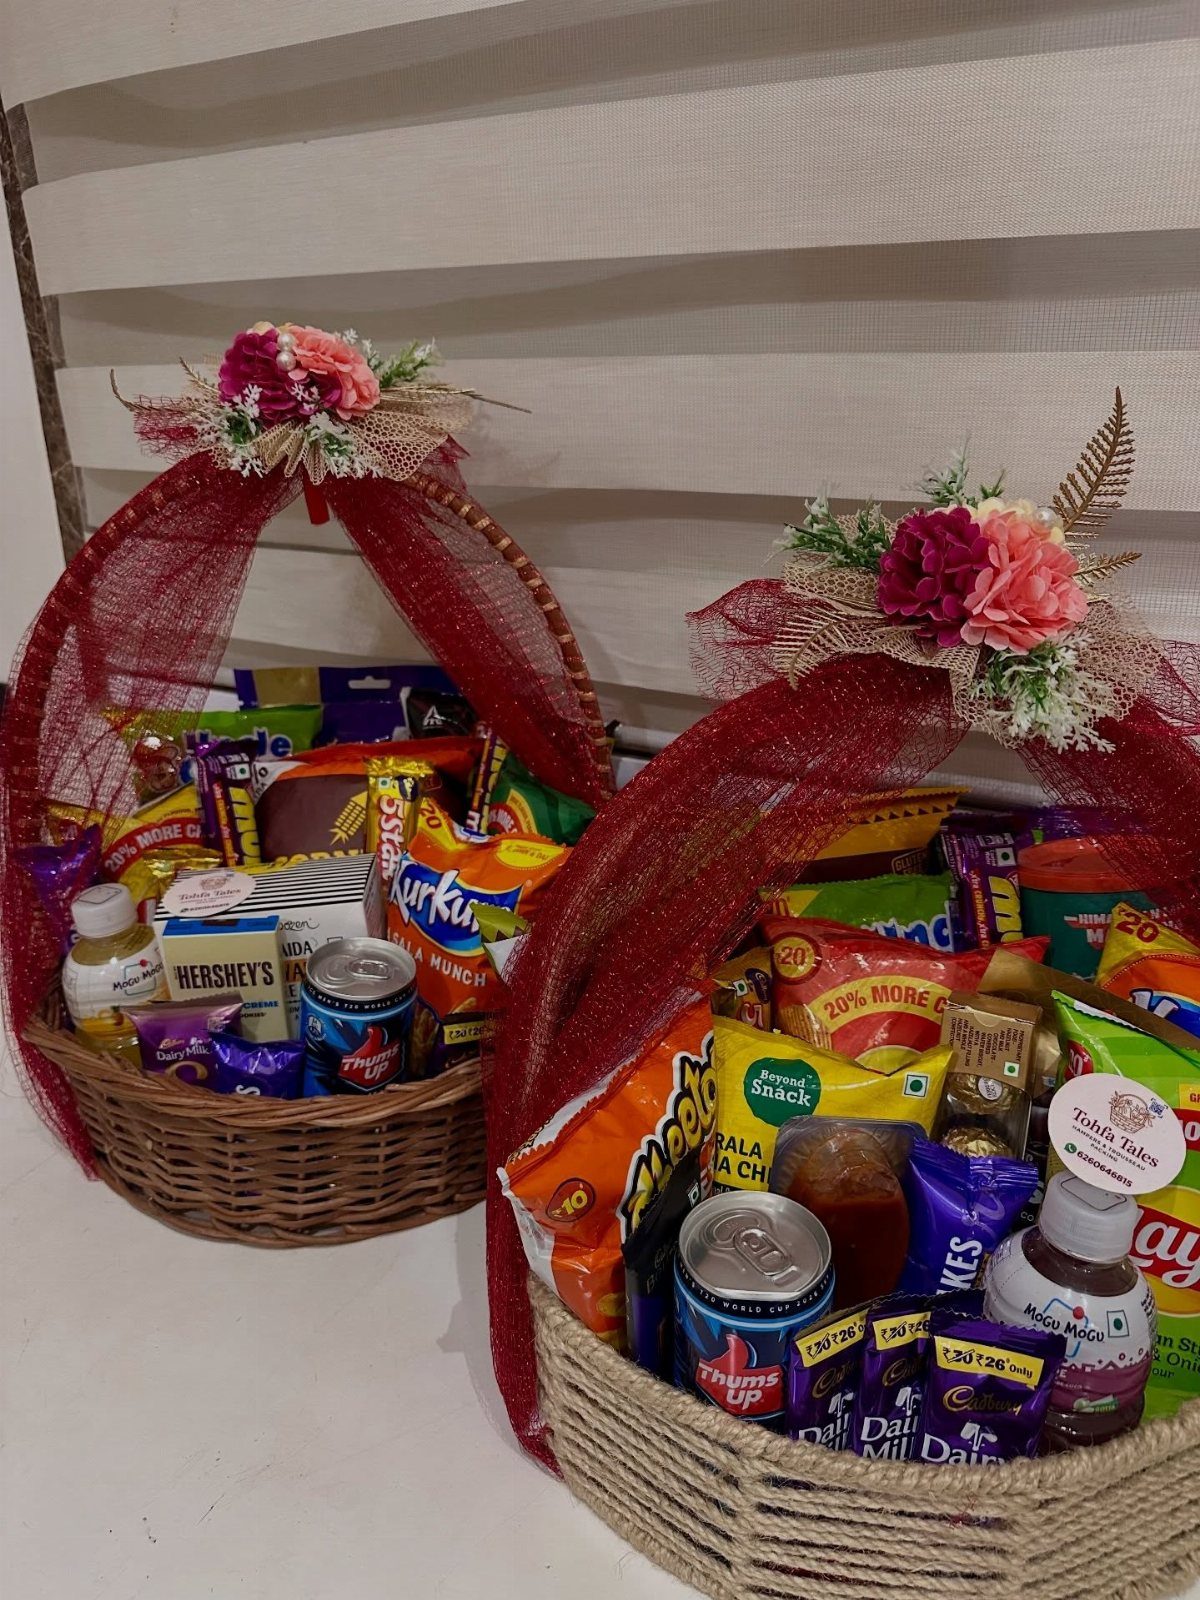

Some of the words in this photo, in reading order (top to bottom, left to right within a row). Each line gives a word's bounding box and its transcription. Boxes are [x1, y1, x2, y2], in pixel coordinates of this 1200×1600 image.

[135, 823, 183, 850] MORE
[176, 960, 275, 990] HERSHEY'S
[430, 952, 487, 988] MUNCH
[823, 989, 867, 1020] 20%
[871, 985, 930, 1008] MORE
[155, 1050, 186, 1061] Dairy
[185, 1045, 210, 1056] Milk
[340, 1043, 400, 1071] Thums
[760, 1069, 806, 1089] Beyond
[1072, 1124, 1101, 1145] HAMPERS
[1108, 1146, 1146, 1171] TROUSSEAU
[1073, 1107, 1115, 1143] Tohfa
[1120, 1135, 1159, 1168] Tales
[1076, 1150, 1133, 1188] 6260646815
[722, 1301, 762, 1314] WORLD
[769, 1304, 790, 1314] CUP
[701, 1366, 780, 1388] Thums
[1009, 1364, 1033, 1379] Only
[942, 1385, 1022, 1416] Cadbury
